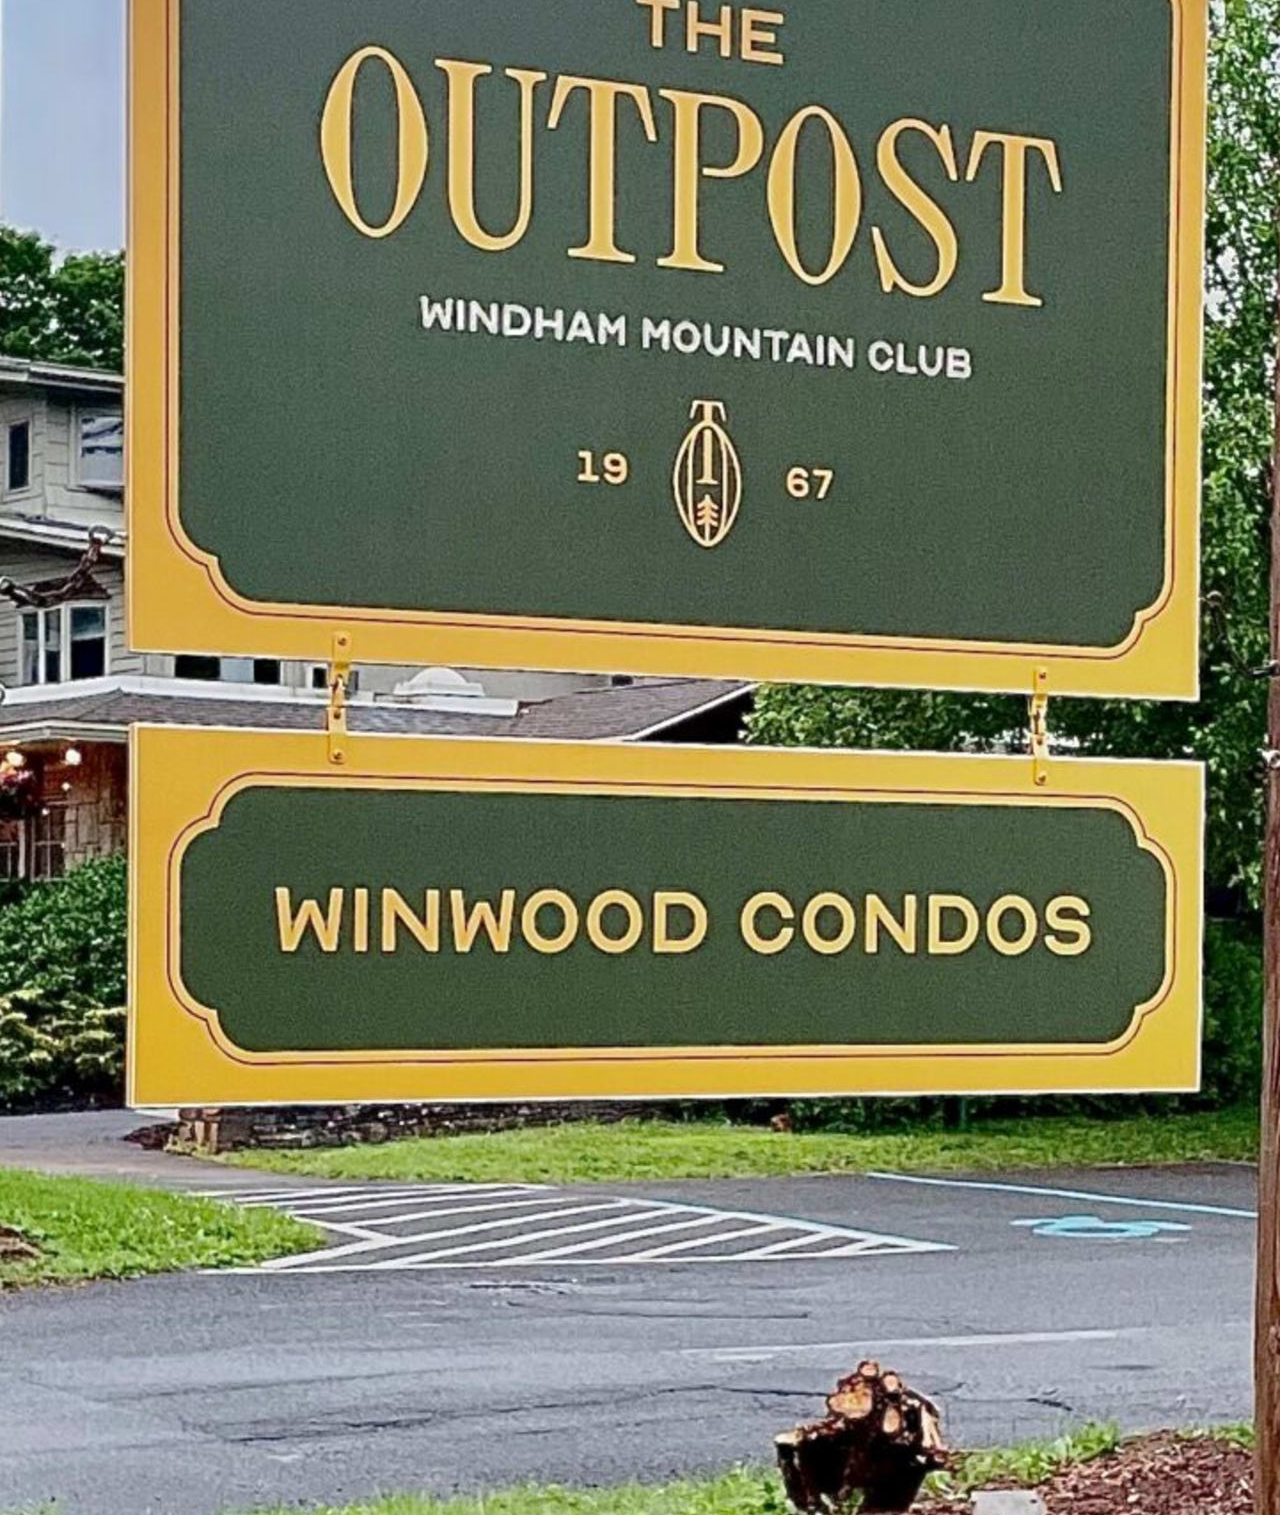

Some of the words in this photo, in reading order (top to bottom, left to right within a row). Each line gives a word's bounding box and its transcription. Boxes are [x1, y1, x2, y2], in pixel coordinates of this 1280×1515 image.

[320, 45, 1063, 308] OUTPOST
[419, 295, 626, 348] WINDHAM
[641, 316, 855, 370] MOUNTAIN
[867, 339, 973, 380] CLUB
[577, 450, 629, 486] 19
[786, 466, 835, 500] 67
[274, 886, 709, 955] WINWOOD
[740, 891, 1094, 957] CONDOS
